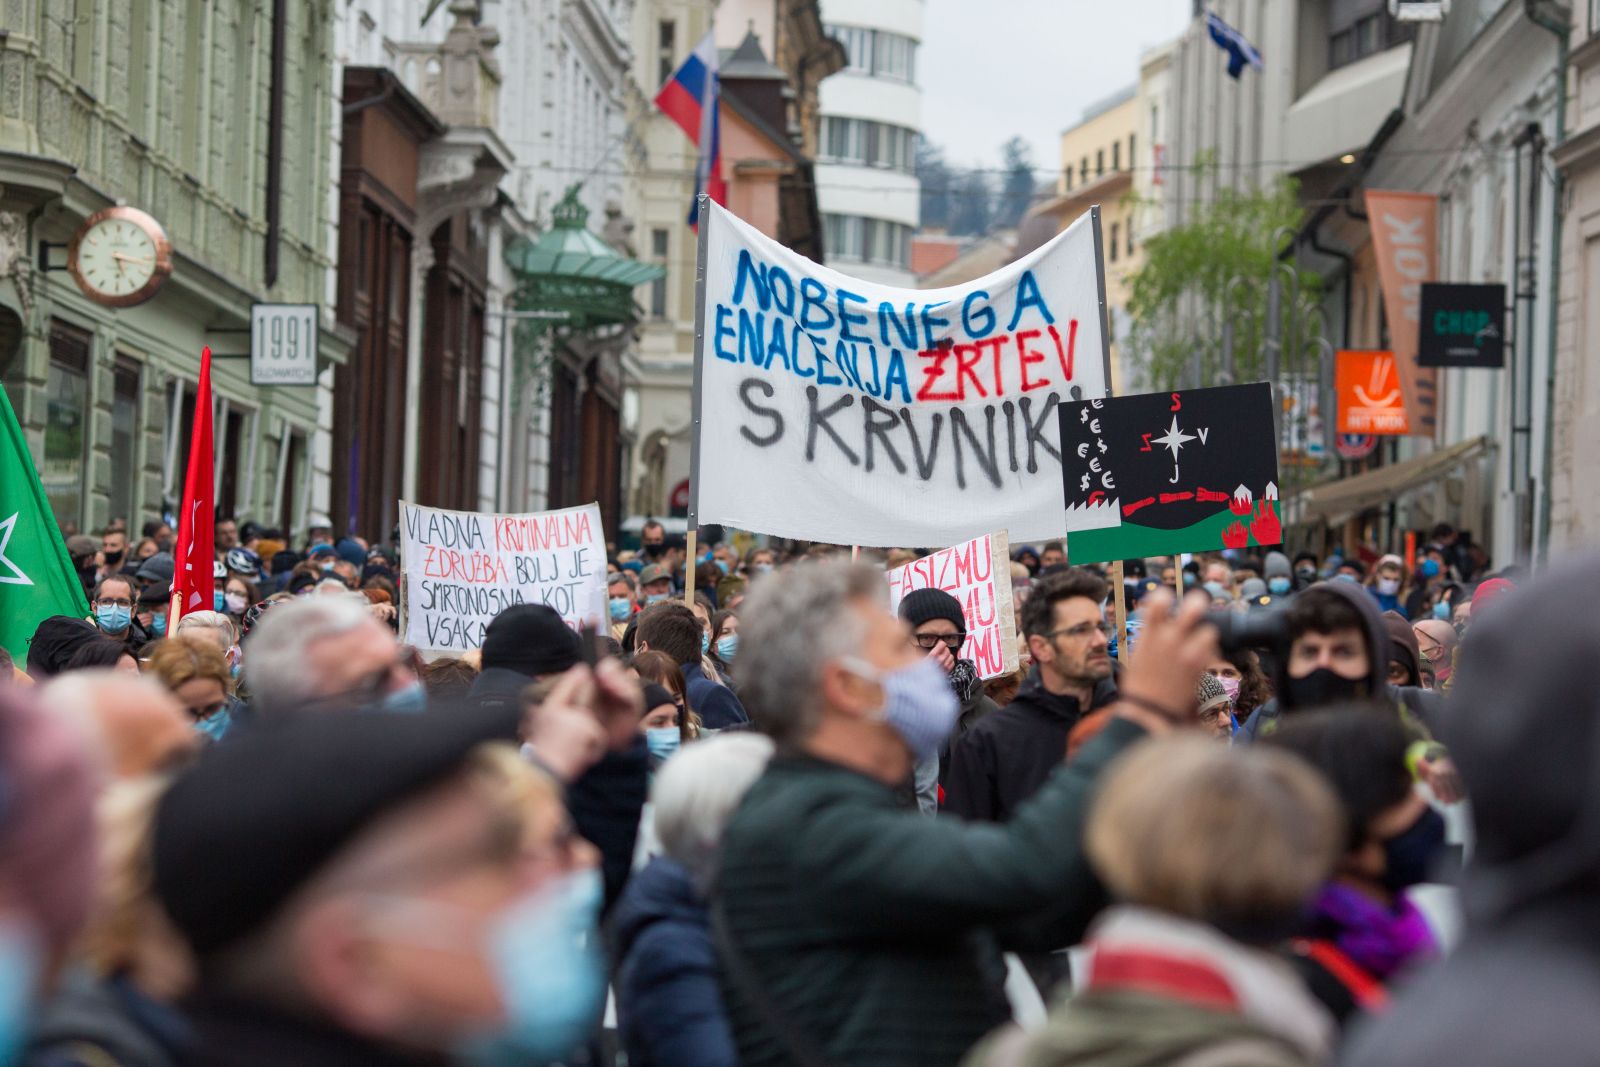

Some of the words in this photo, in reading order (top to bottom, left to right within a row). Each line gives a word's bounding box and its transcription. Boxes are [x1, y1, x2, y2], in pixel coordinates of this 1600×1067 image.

[258, 314, 312, 360] 1991
[738, 377, 786, 448] S
[805, 386, 1083, 490] KRVNIK
[405, 505, 485, 550] VLADNA
[494, 511, 592, 552] KRIMINALNA
[515, 553, 559, 585] BOLJ
[569, 548, 592, 579] JE
[541, 581, 584, 616] KOT
